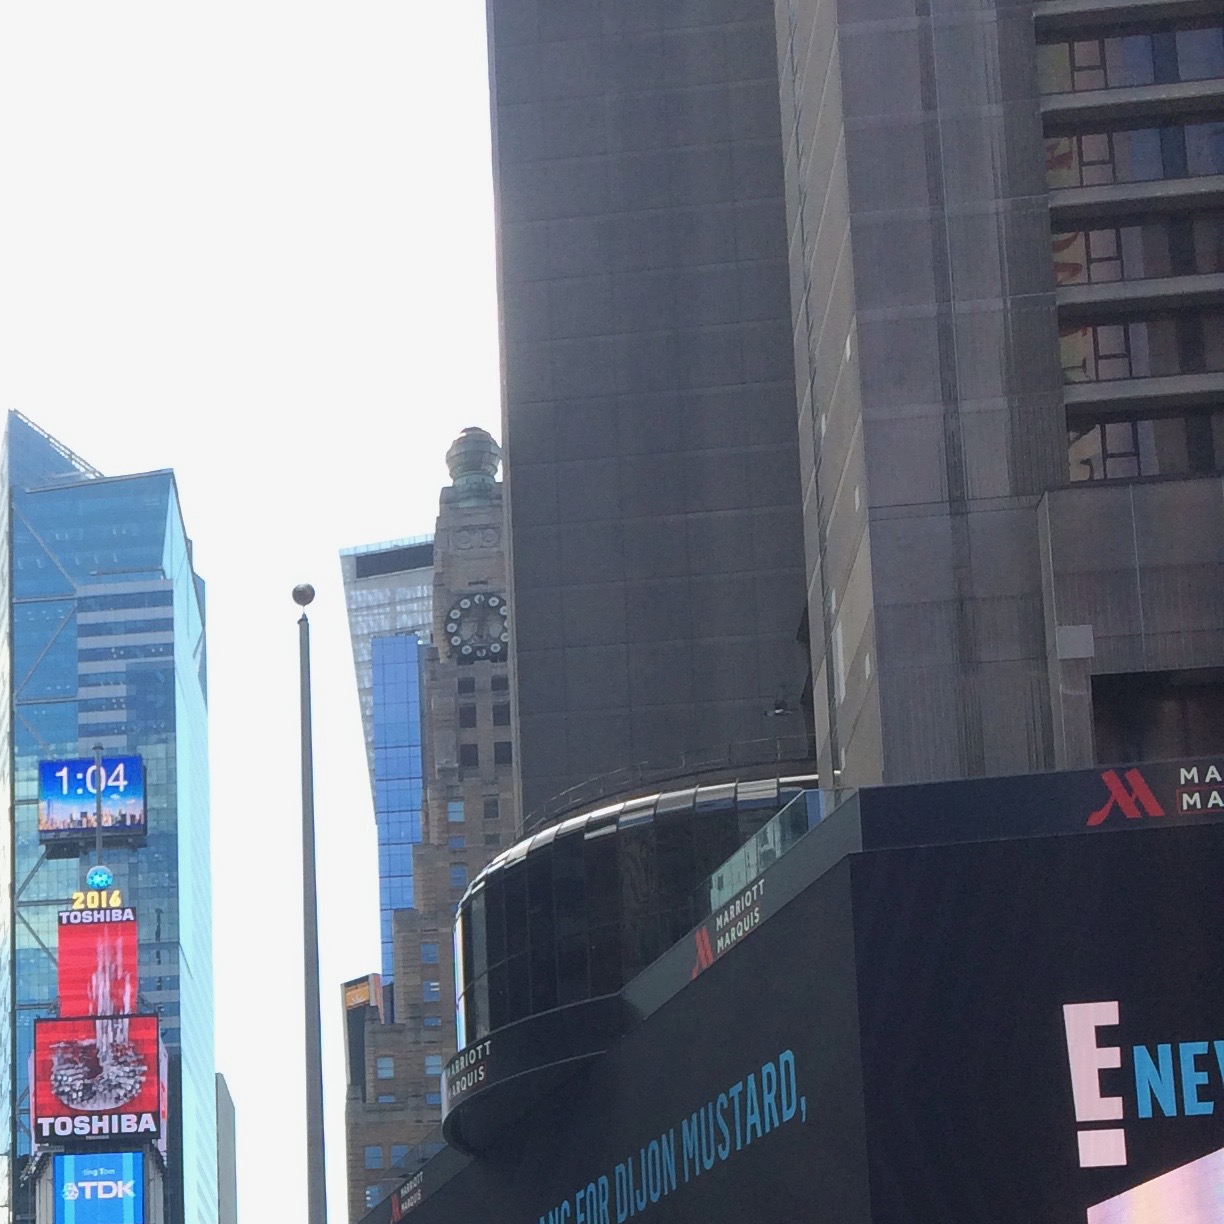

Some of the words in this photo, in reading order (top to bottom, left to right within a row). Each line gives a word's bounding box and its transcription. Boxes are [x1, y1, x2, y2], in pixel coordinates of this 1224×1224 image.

[54, 763, 129, 795] 1:04
[72, 890, 122, 909] 2016
[715, 879, 766, 931] MARRIOTT
[59, 908, 135, 924] TOSHIBA
[716, 907, 761, 953] MARQUIS
[37, 1113, 157, 1137] TOSHIBA
[614, 1128, 677, 1224] DIJON
[681, 1049, 808, 1183] MUSTARD,
[78, 1180, 136, 1199] TDK
[399, 1171, 425, 1197] MARRIOTT
[400, 1188, 422, 1211] MARQUIS
